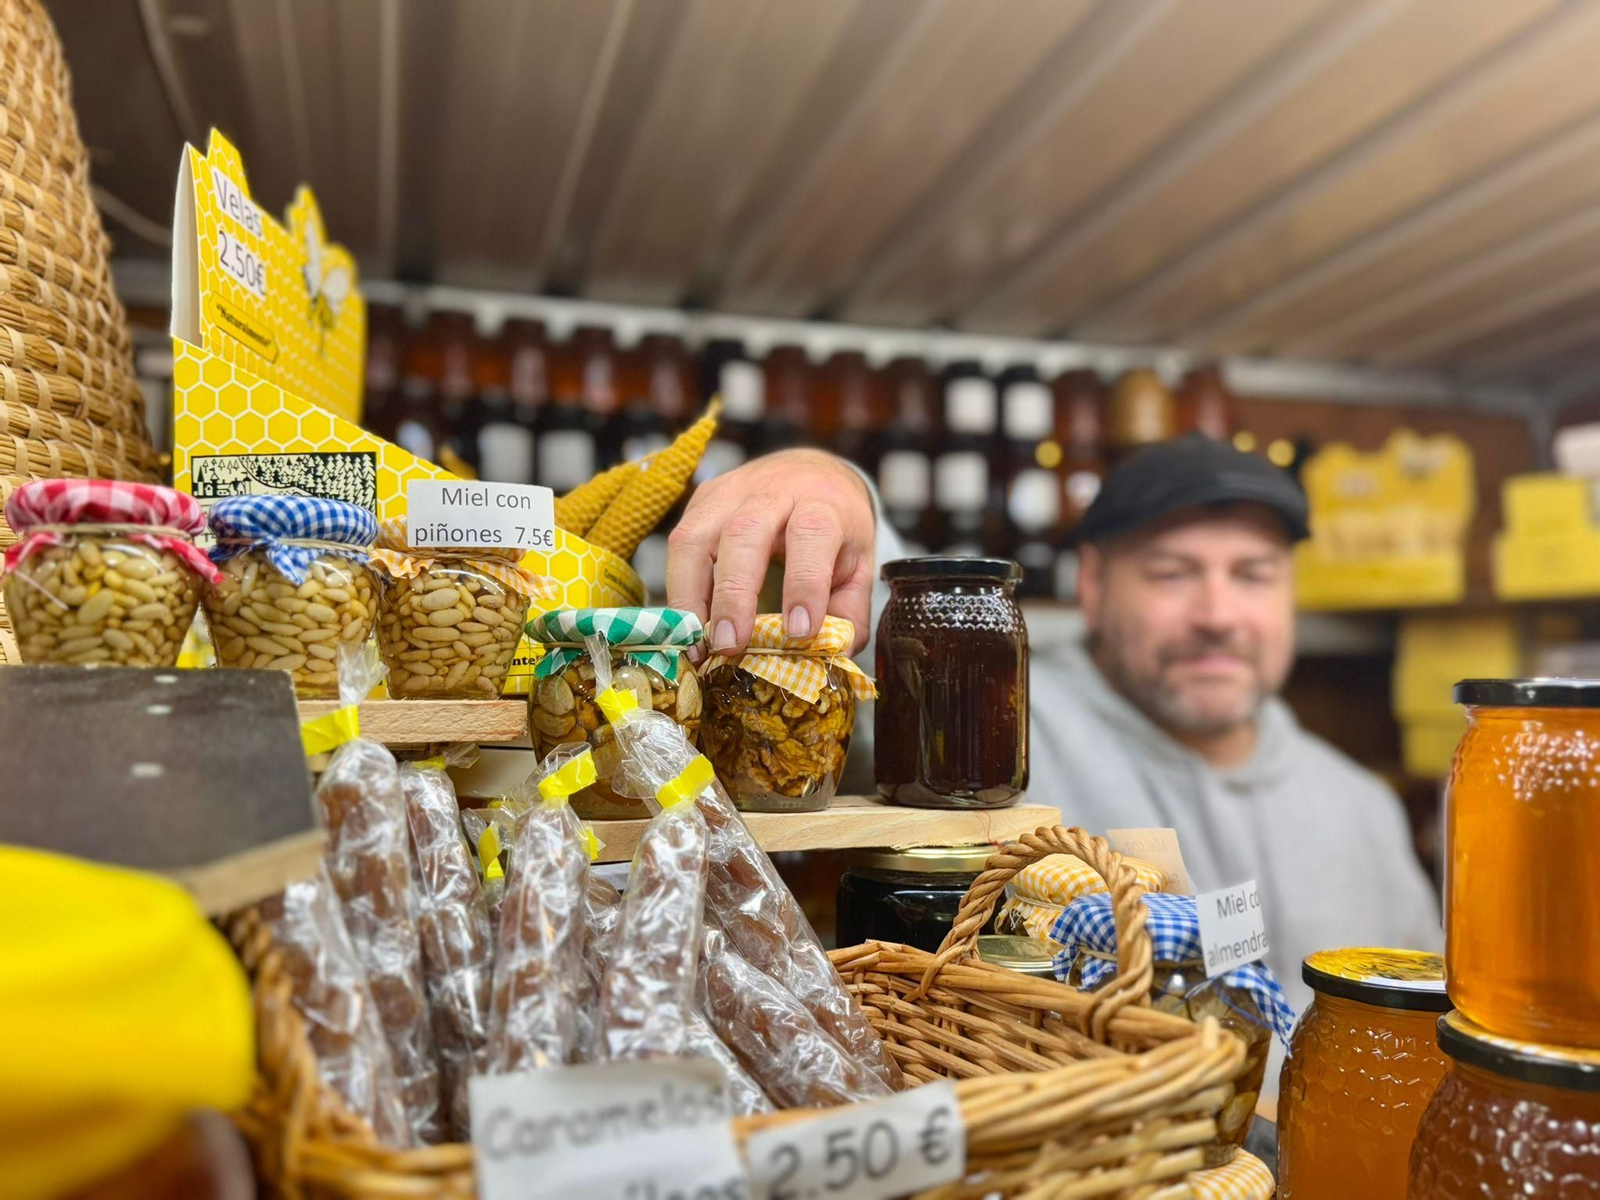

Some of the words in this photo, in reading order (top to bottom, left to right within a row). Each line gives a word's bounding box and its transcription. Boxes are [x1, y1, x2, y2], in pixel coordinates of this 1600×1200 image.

[214, 171, 263, 238] Velas
[219, 230, 266, 296] 2.50€
[442, 487, 489, 507] Miel
[496, 494, 531, 510] con
[415, 523, 502, 546] piñones
[514, 526, 553, 547] 7.5€
[1216, 889, 1248, 919] Miel
[768, 1120, 900, 1200] 2.50
[919, 1105, 951, 1165] €
